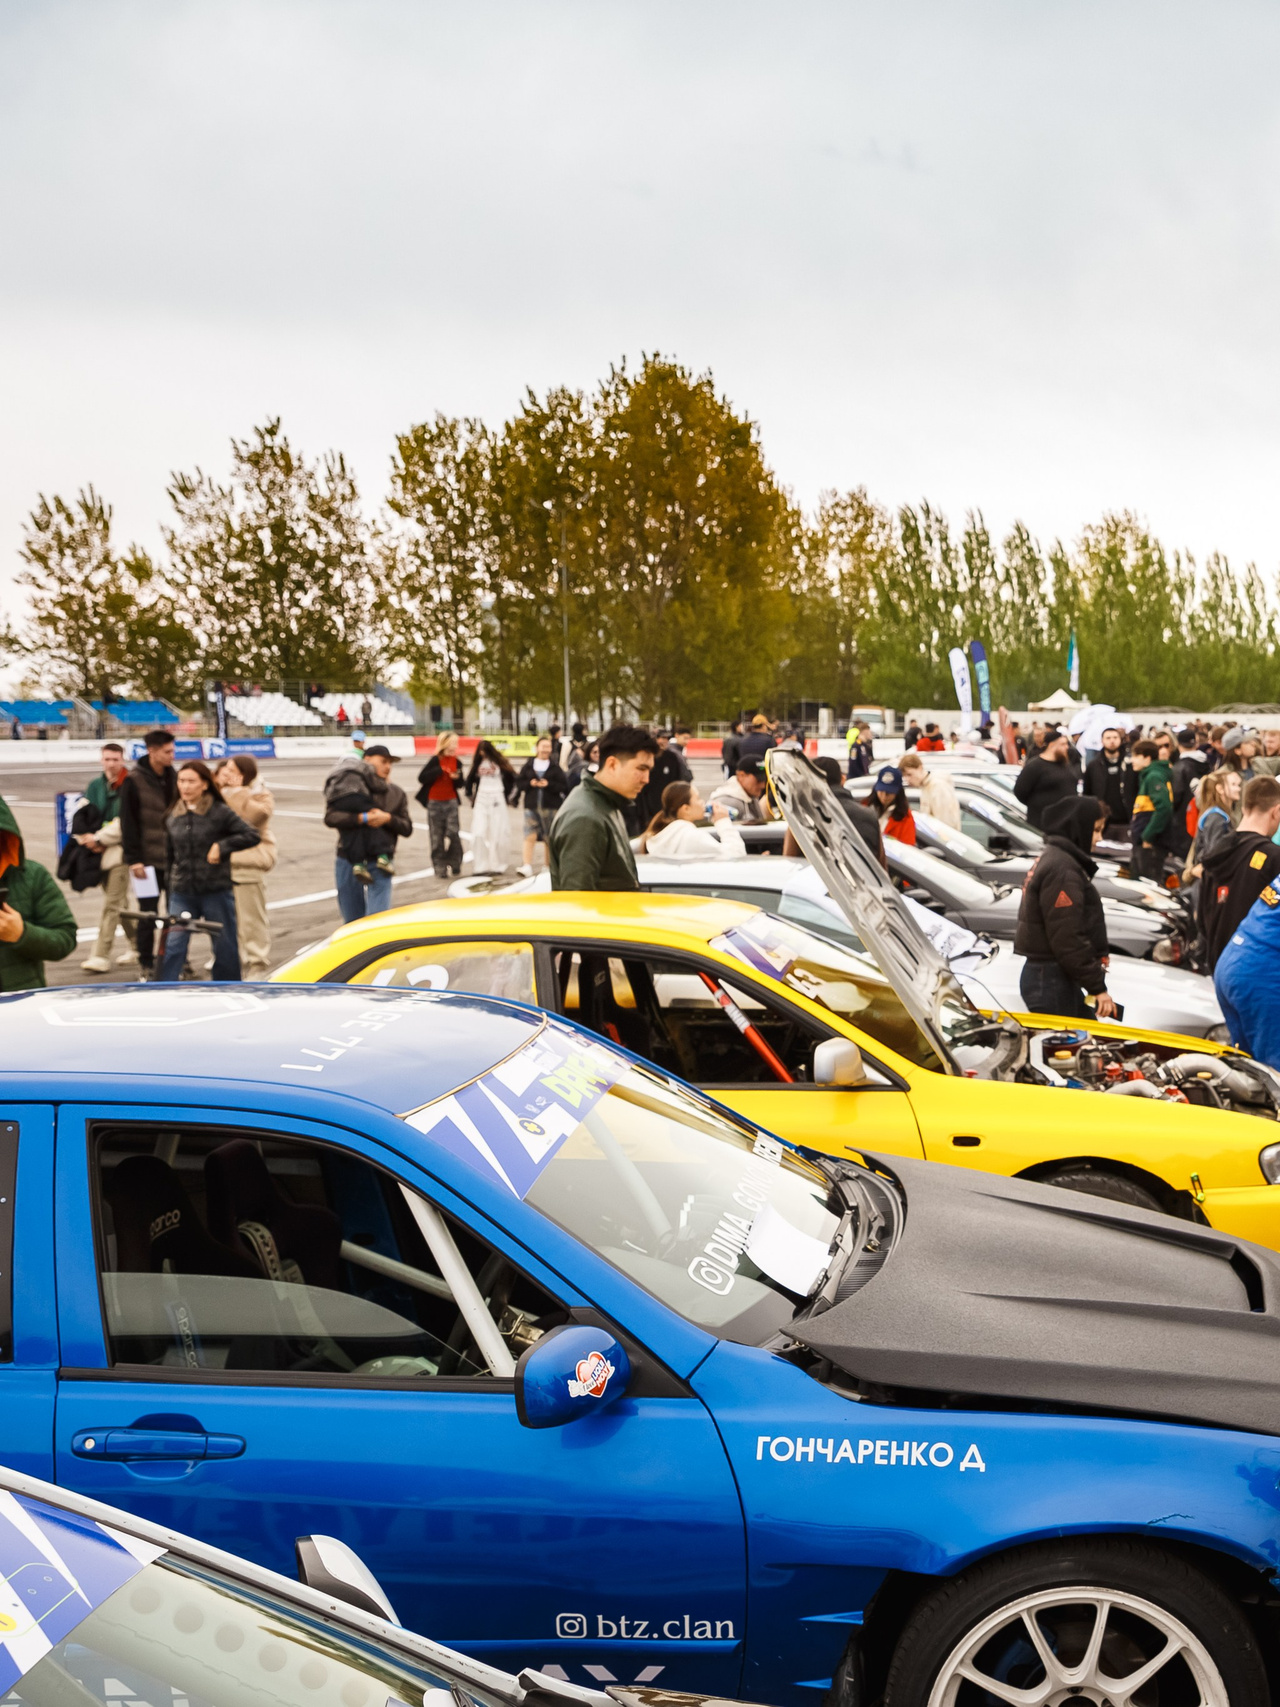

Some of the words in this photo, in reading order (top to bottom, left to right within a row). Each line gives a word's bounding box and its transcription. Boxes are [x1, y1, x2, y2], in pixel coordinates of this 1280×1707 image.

[756, 1436, 954, 1467] ГОНЧАРЕНКО
[959, 1443, 986, 1472] Д
[597, 1614, 736, 1639] btz.clan
